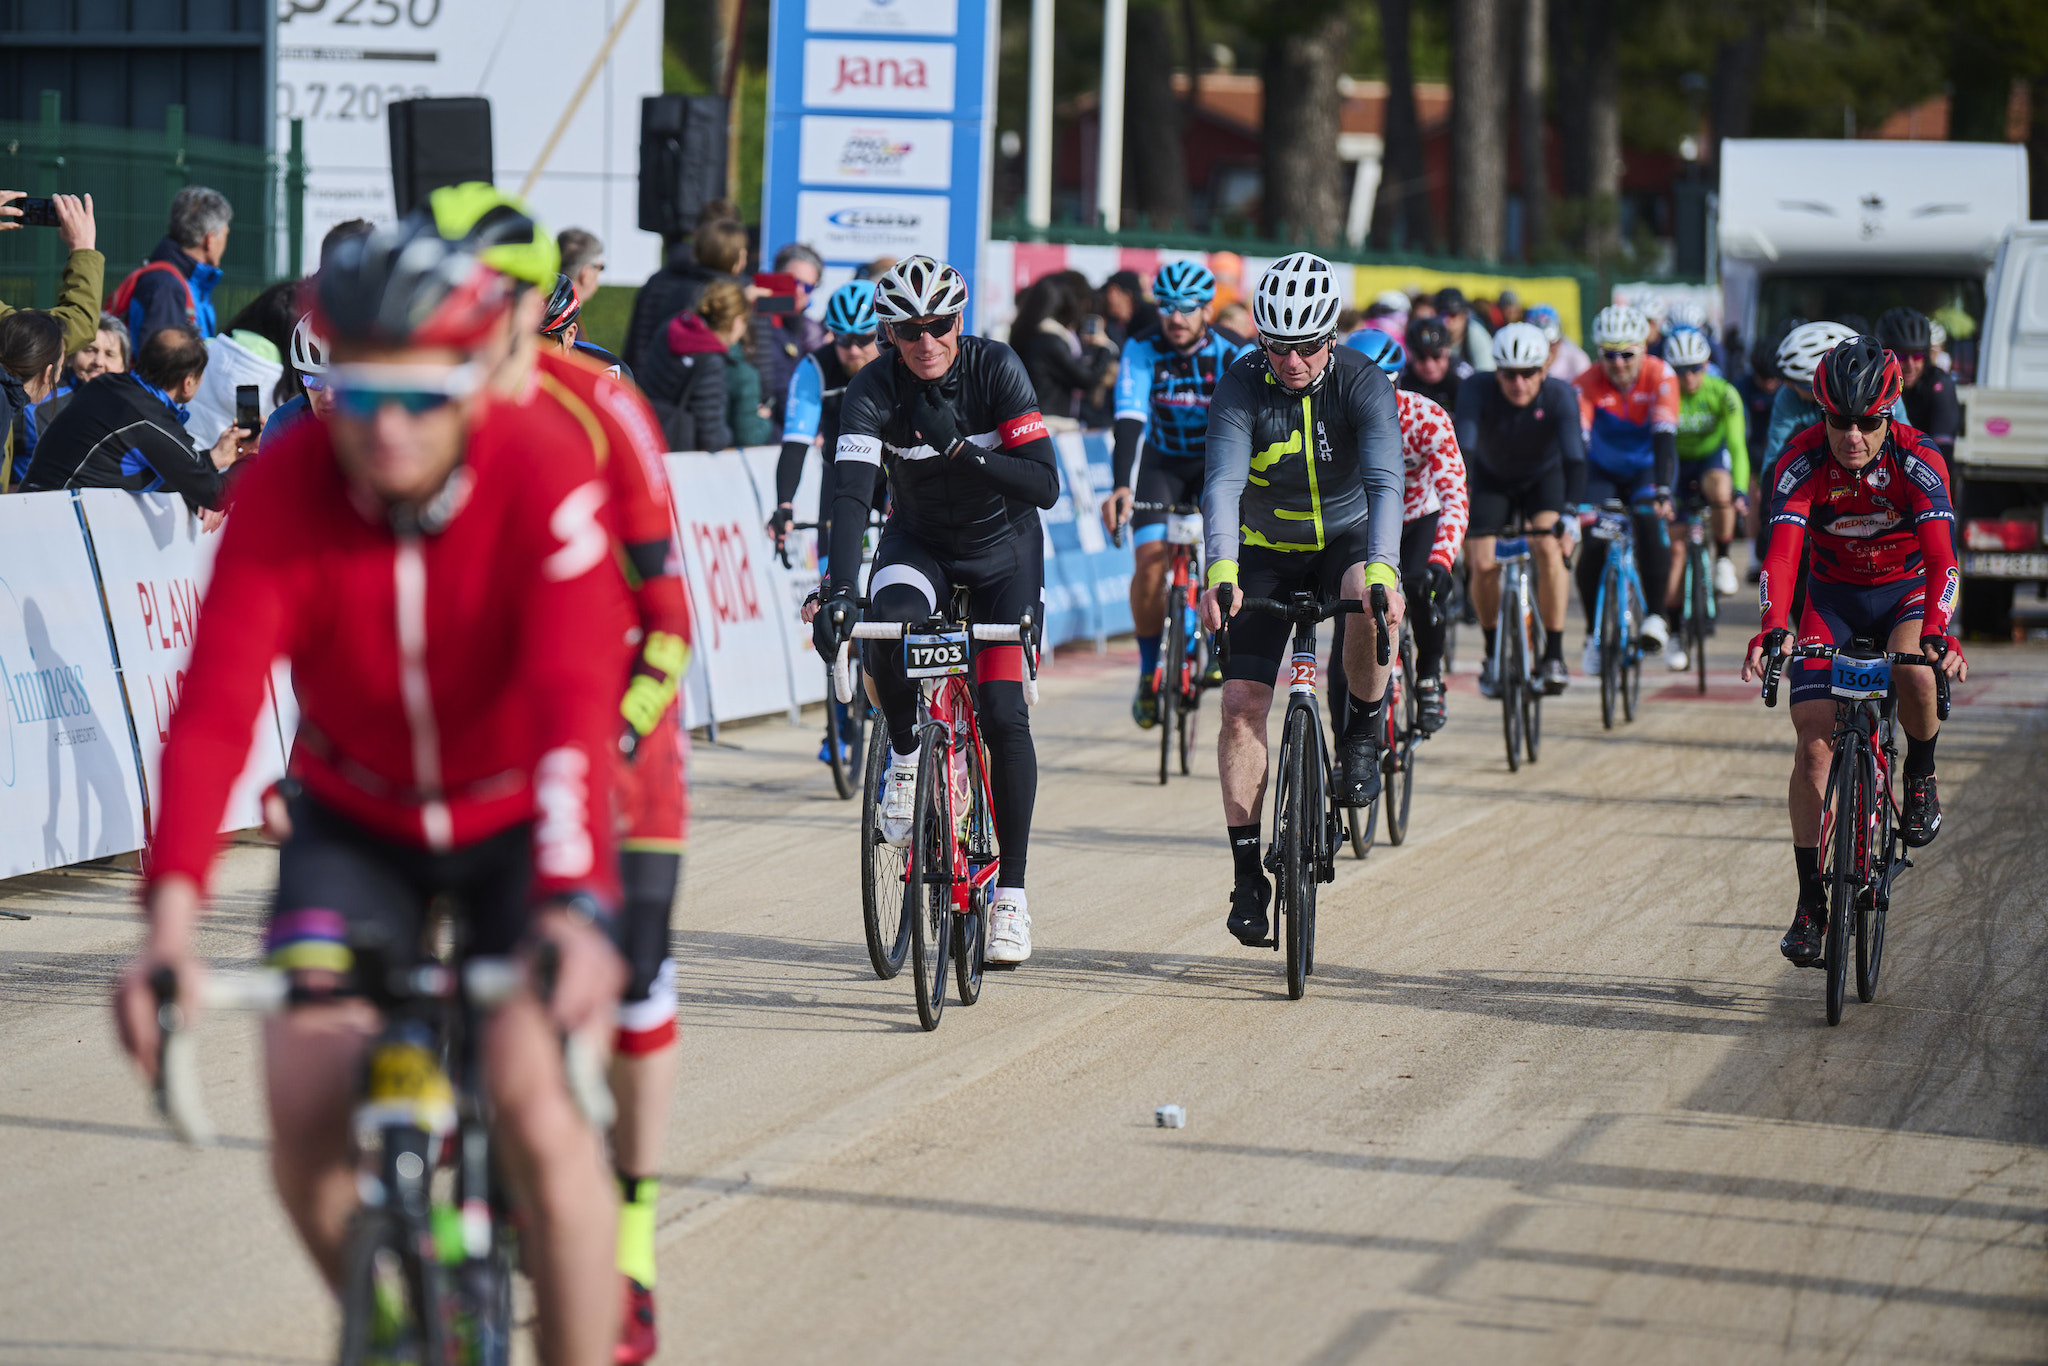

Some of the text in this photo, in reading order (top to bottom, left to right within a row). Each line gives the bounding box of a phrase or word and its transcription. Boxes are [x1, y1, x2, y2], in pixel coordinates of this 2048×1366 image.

[911, 645, 962, 666] 1703
[0, 646, 91, 724] Aminess
[1838, 669, 1884, 687] 1304
[895, 772, 914, 781] SIDI
[997, 904, 1017, 912] SIDI
